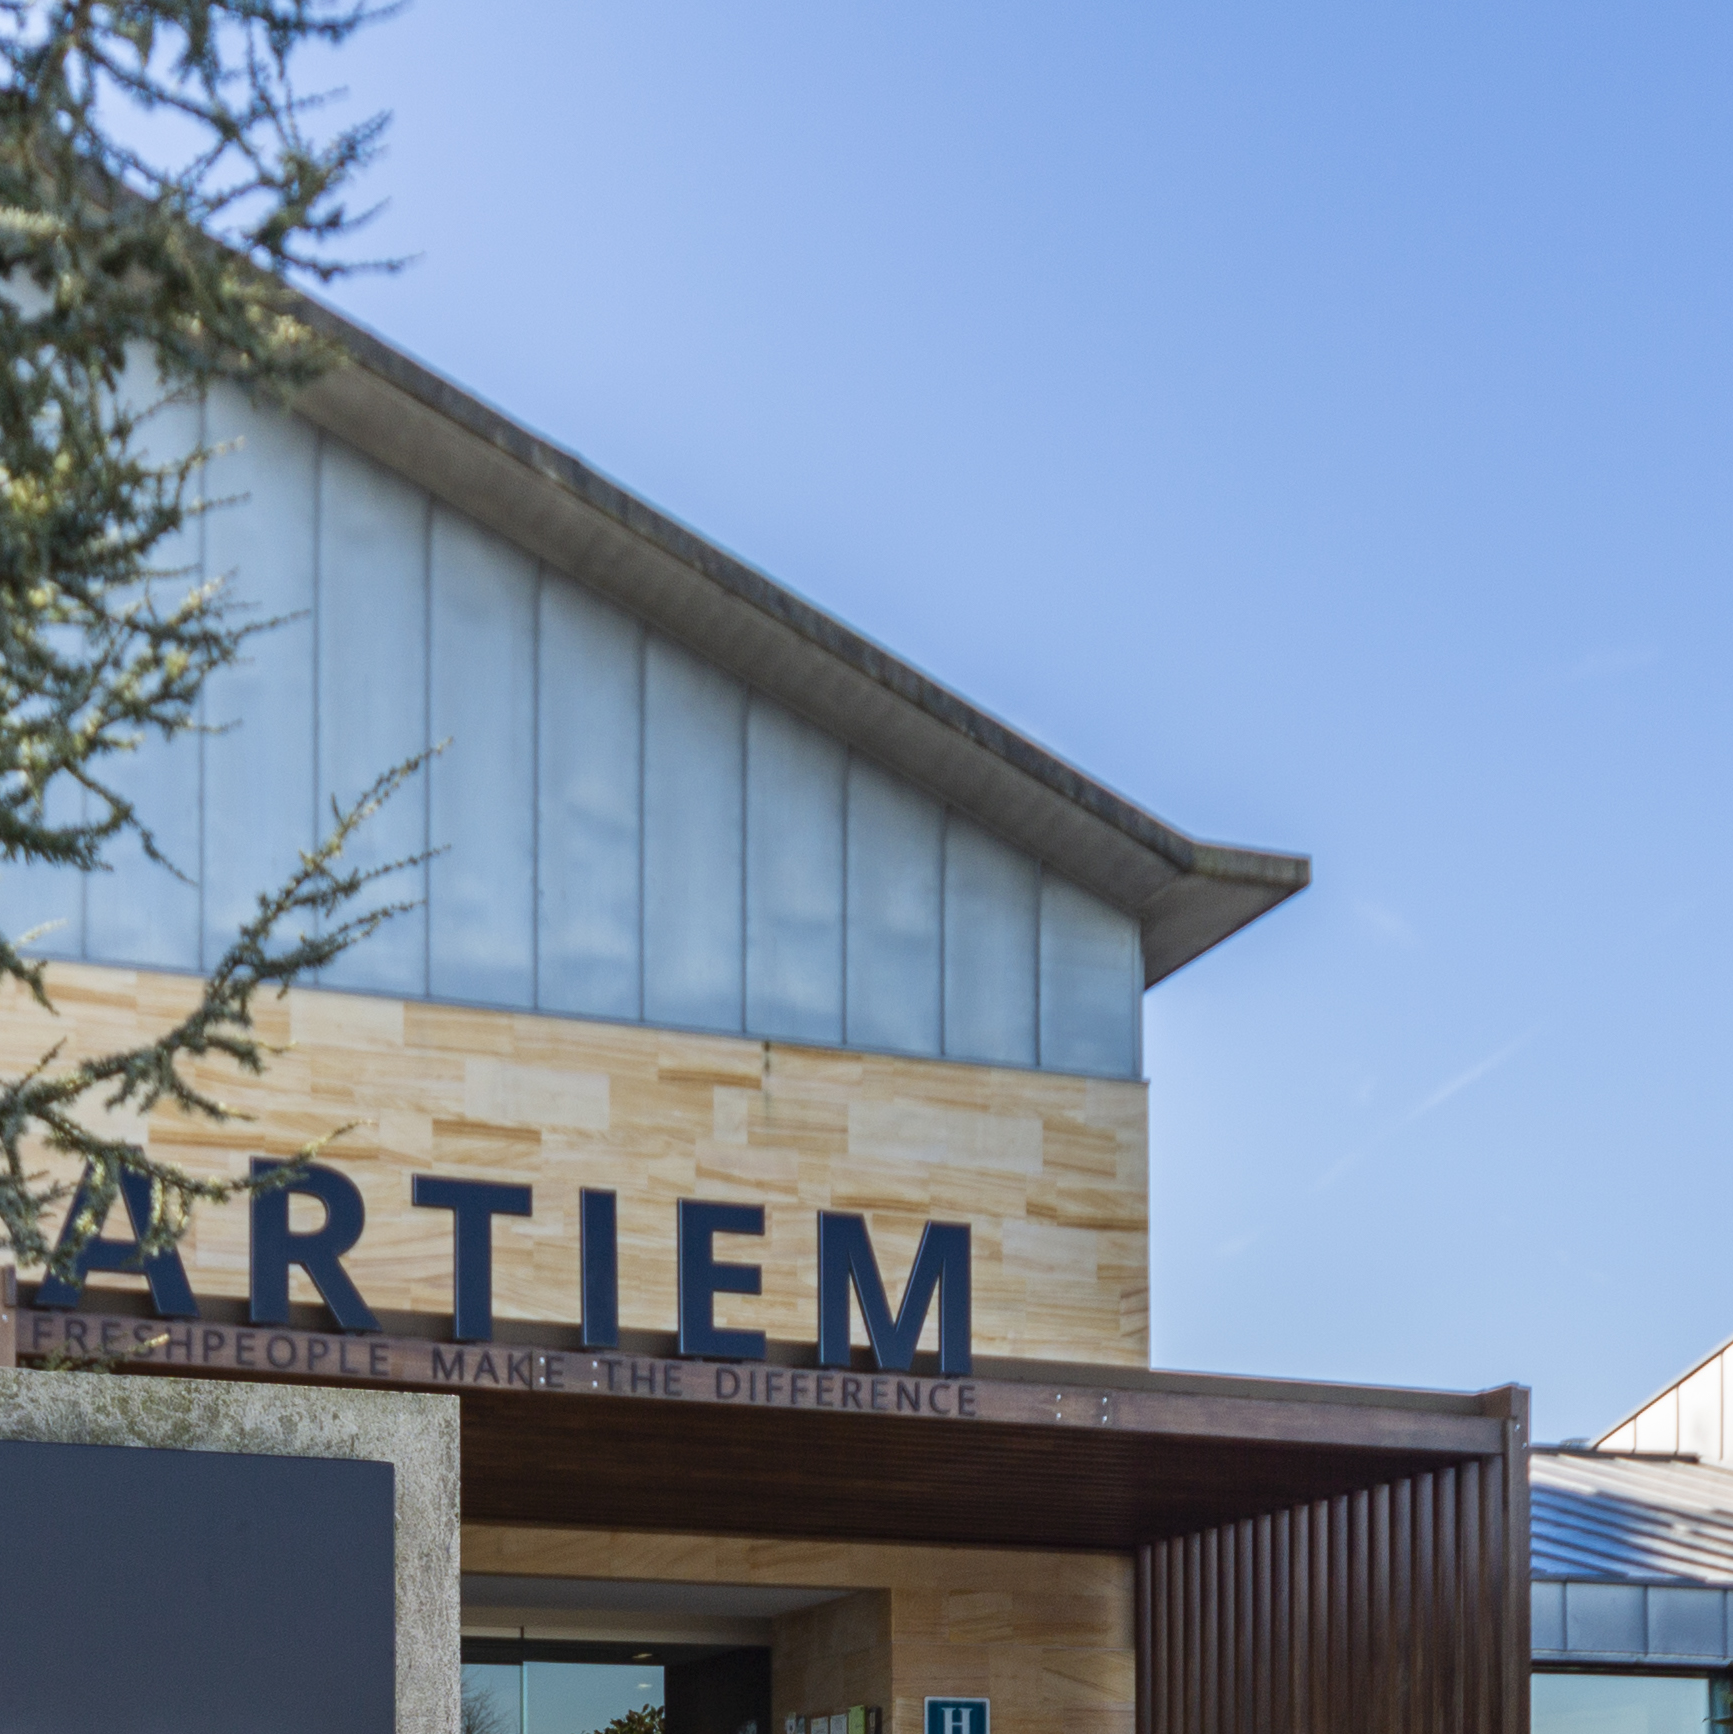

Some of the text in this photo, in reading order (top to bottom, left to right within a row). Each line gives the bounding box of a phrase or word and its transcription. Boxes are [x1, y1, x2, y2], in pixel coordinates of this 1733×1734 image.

[35, 1145, 972, 1377] ARTIEM
[32, 1316, 977, 1418] FRESHPEOPLE MAKE THE DIFFERENCE
